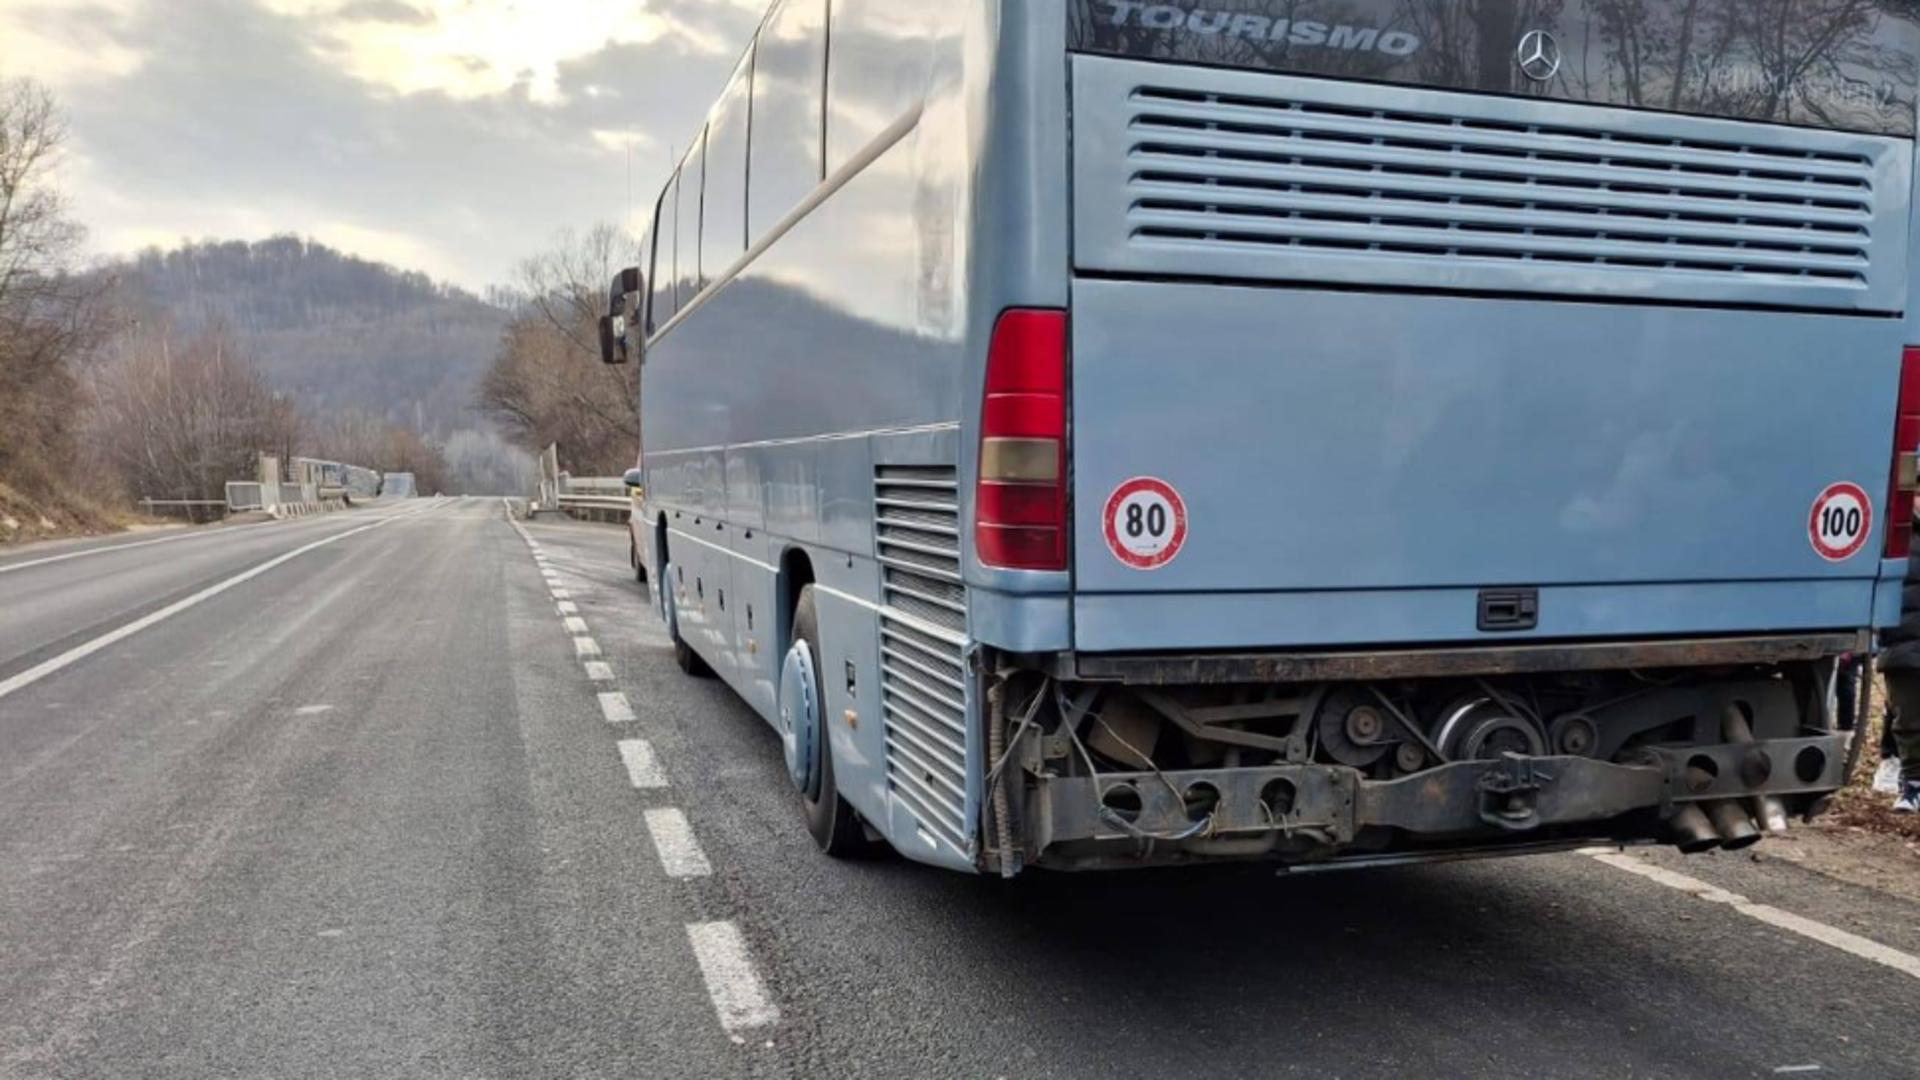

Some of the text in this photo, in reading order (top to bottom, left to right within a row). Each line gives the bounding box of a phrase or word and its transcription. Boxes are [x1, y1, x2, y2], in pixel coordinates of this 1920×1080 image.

[1106, 2, 1420, 56] TOURISMO
[1126, 502, 1165, 537] 80
[1822, 507, 1860, 537] 100
